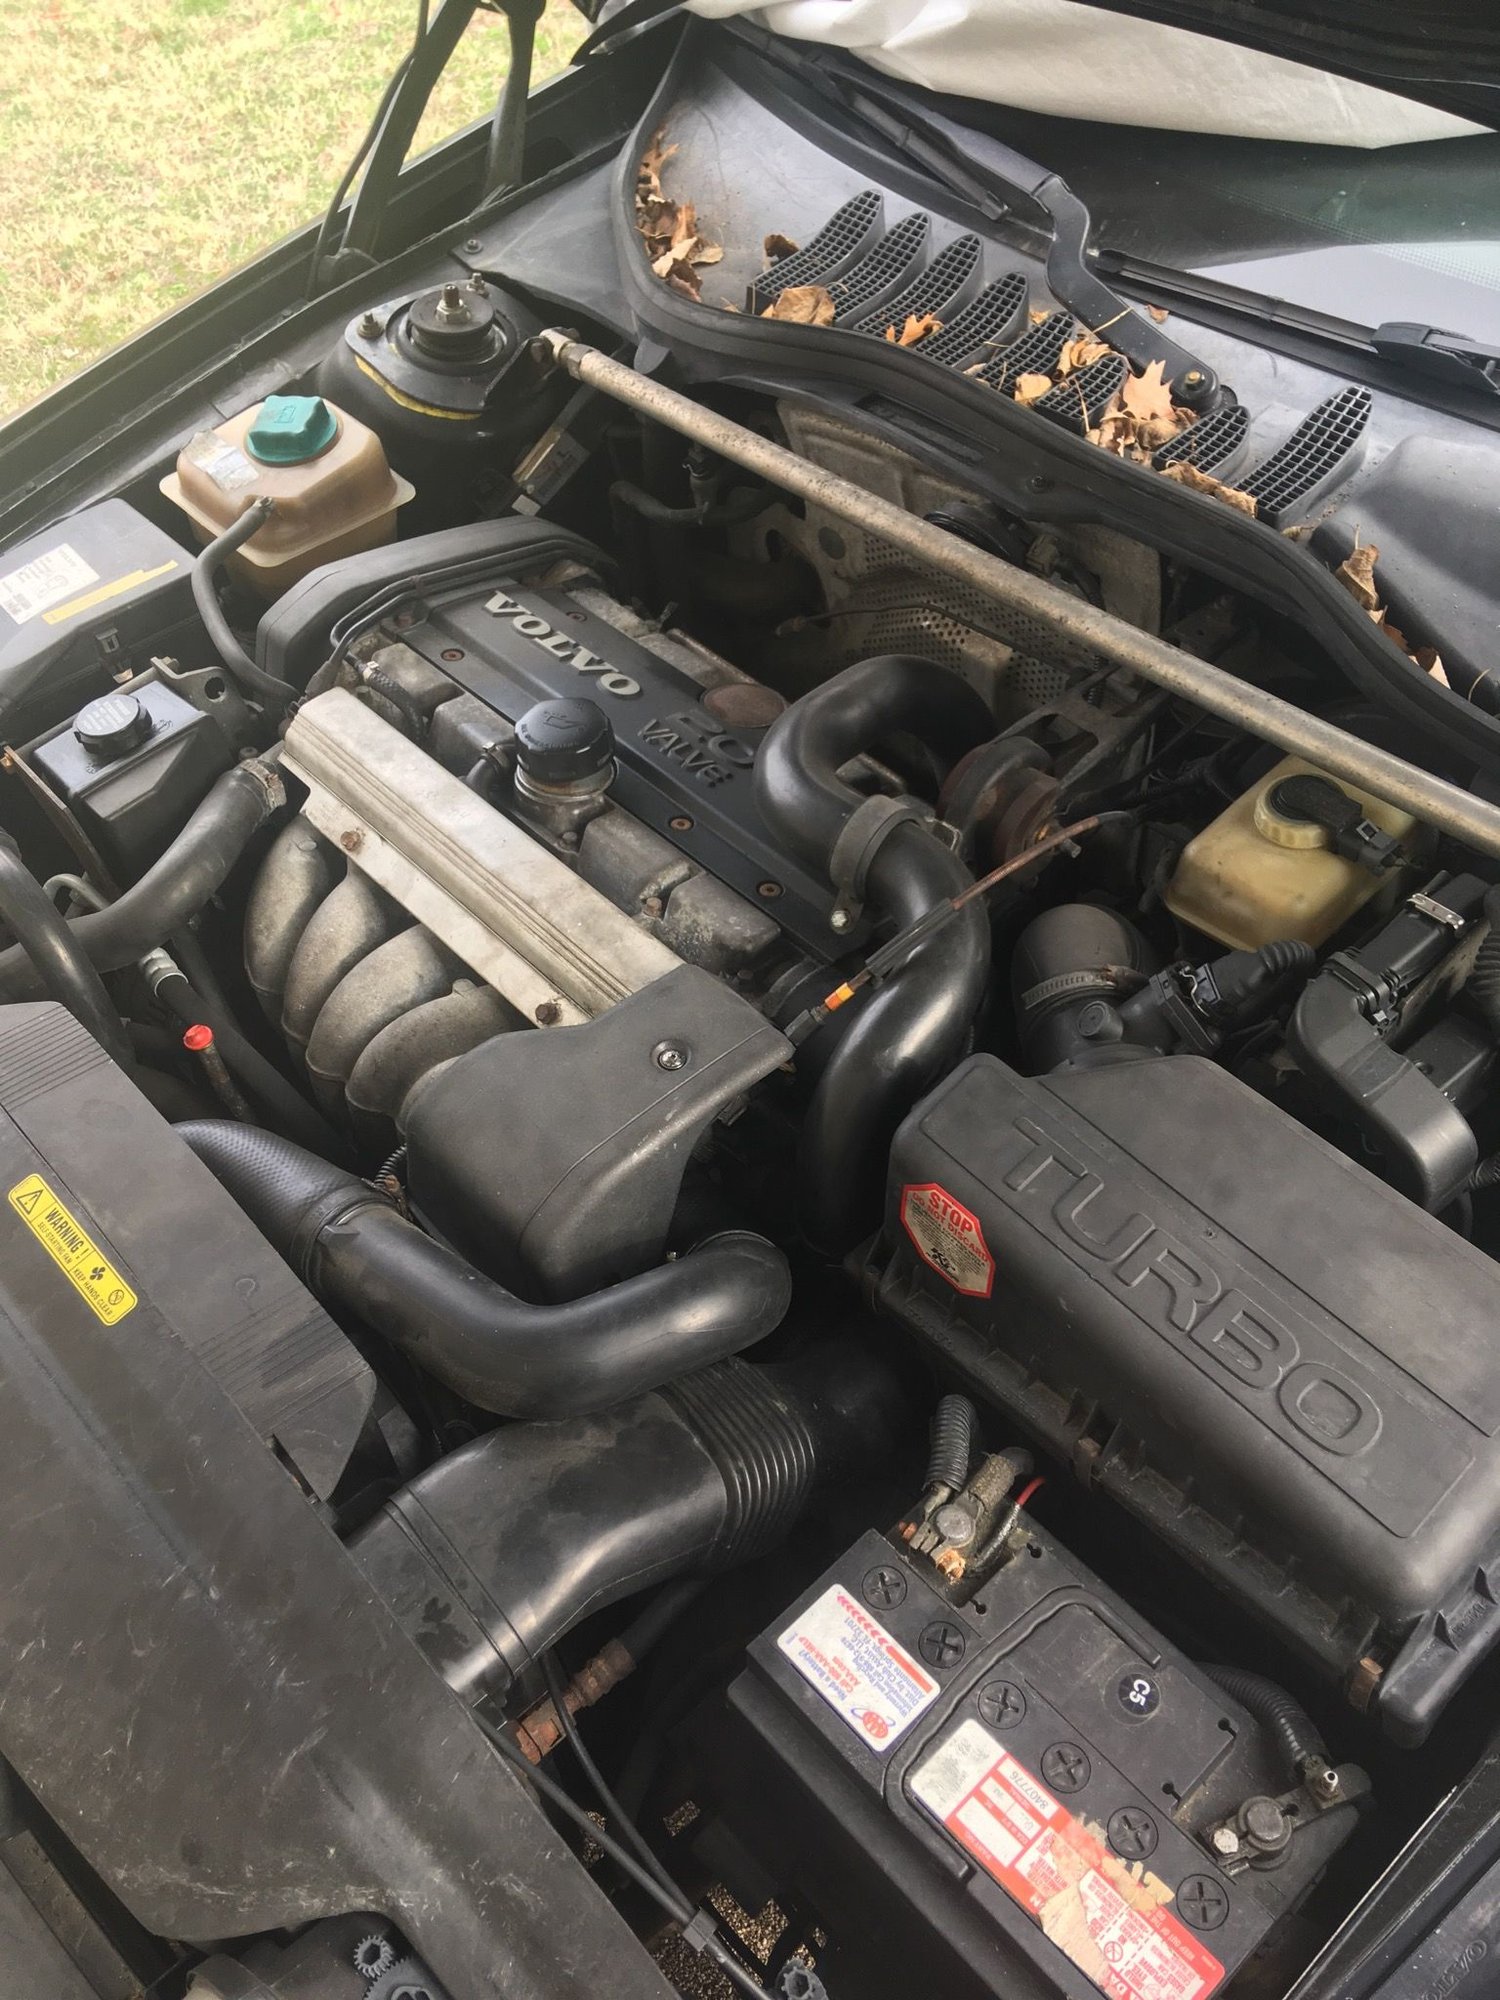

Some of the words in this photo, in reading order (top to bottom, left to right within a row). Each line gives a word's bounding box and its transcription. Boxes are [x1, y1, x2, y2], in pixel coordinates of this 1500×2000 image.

[485, 590, 640, 695] VOLVO
[637, 719, 733, 787] VALVE
[929, 1192, 972, 1233] STOP
[44, 1207, 84, 1254] WARNING
[913, 1192, 925, 1206] DO
[928, 1207, 945, 1223] NOT
[947, 1224, 986, 1262] DISCARD
[62, 1253, 72, 1265] FAN
[73, 1268, 86, 1283] KEEP
[83, 1282, 99, 1301] HANDS
[96, 1298, 113, 1317] CLEAR
[1002, 1117, 1383, 1457] TURBO
[843, 1616, 864, 1637] 32701
[860, 1633, 872, 1645] FL
[797, 1634, 843, 1680] 800-AAA-HELP
[797, 1647, 827, 1679] Battery?
[850, 1655, 877, 1683] Recycling
[861, 1645, 884, 1668] Assist,
[868, 1641, 896, 1669] Springs,
[830, 1655, 861, 1687] AAA.com
[838, 1677, 854, 1693] Call
[872, 1669, 885, 1682] Call
[880, 1665, 897, 1682] Club
[890, 1666, 925, 1701] Altamonte
[894, 1679, 906, 1691] by
[828, 1681, 847, 1701] Need
[873, 1680, 885, 1694] and
[881, 1679, 913, 1712] Information
[903, 1689, 919, 1706] Dist.
[1129, 1679, 1150, 1706] C5
[882, 1689, 909, 1717] Warranty
[1008, 1769, 1049, 1810] 8407776
[1035, 1856, 1056, 1876] WATER
[1167, 1933, 1182, 1947] OUT
[1122, 1968, 1145, 1990] SHIELD
[1137, 1957, 1169, 1987] EXPLOSIVE
[1165, 1973, 1186, 1993] GASES
